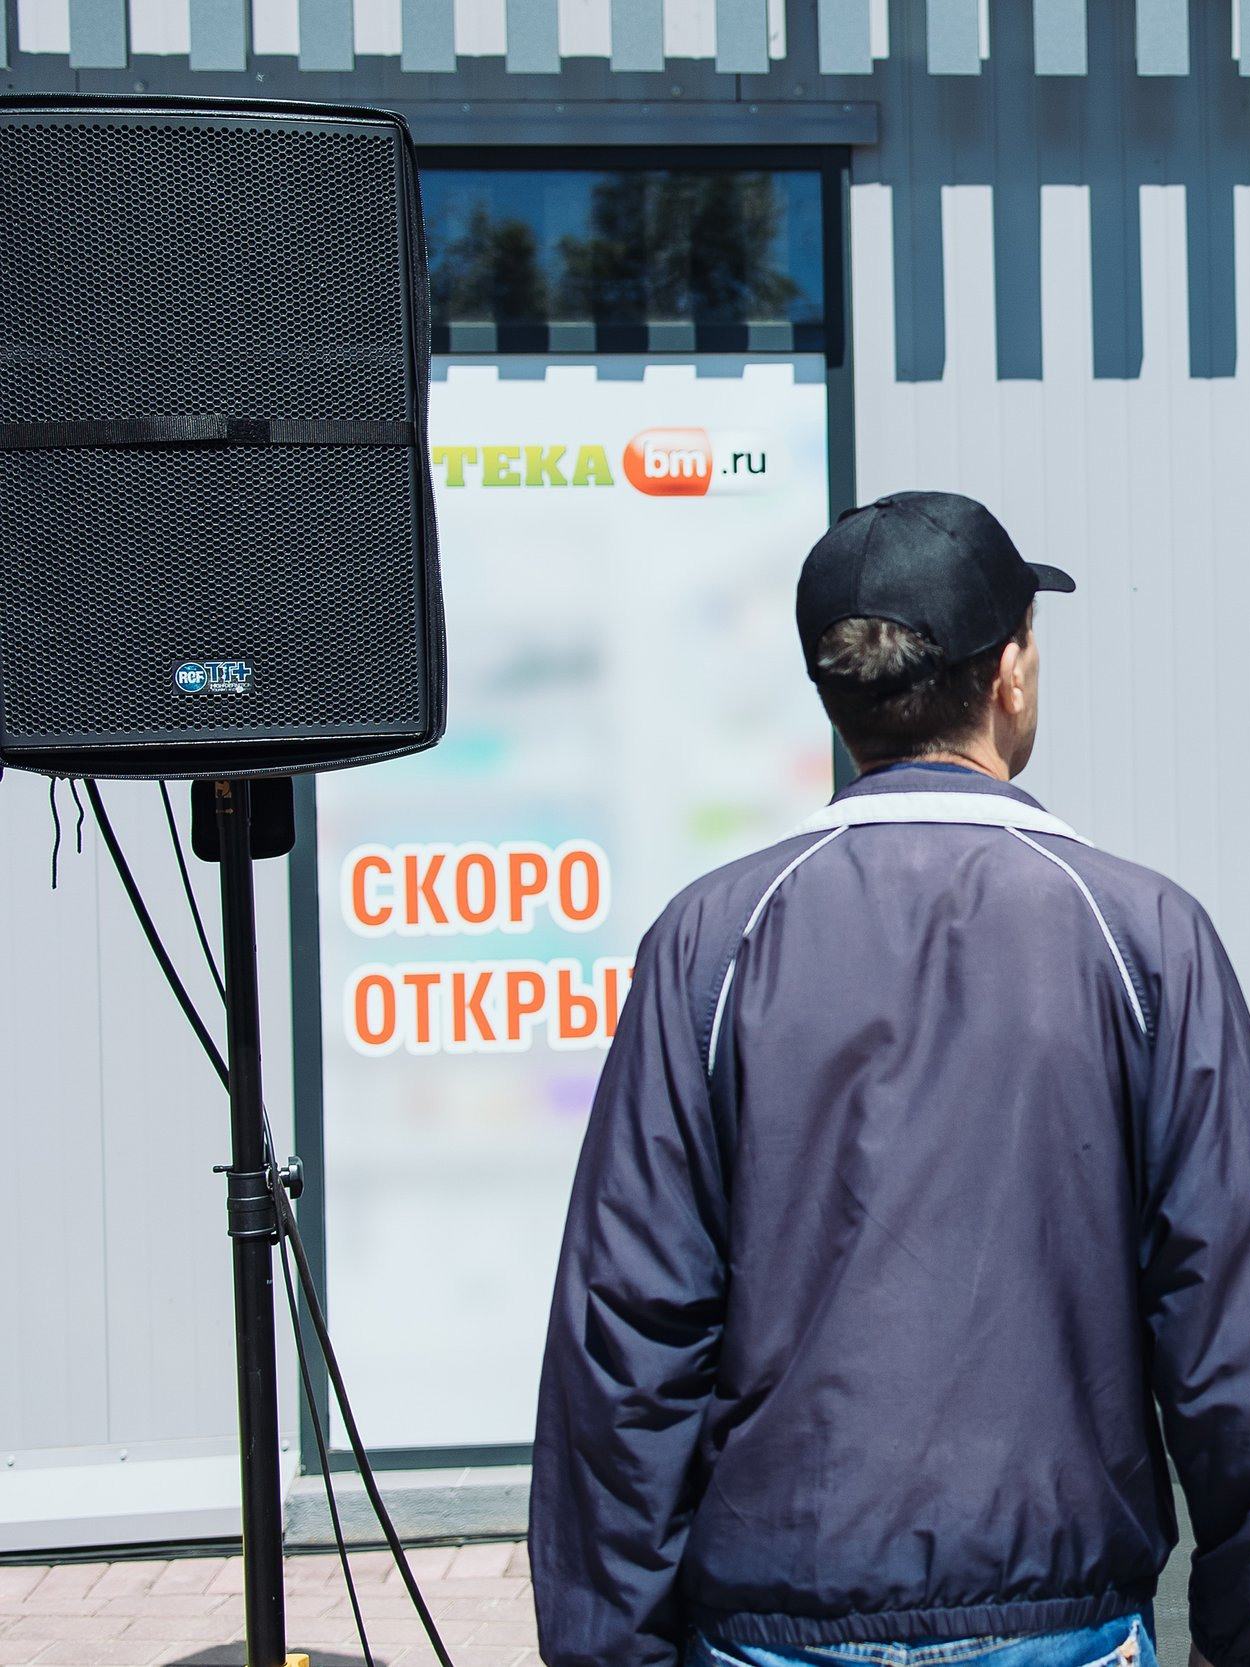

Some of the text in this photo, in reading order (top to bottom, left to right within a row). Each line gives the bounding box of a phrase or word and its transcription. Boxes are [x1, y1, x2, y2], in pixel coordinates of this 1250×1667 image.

[722, 452, 766, 474] .ru
[178, 671, 205, 684] RCF
[352, 850, 600, 926] СКОРО
[354, 967, 634, 1045] ОТКРЫ
